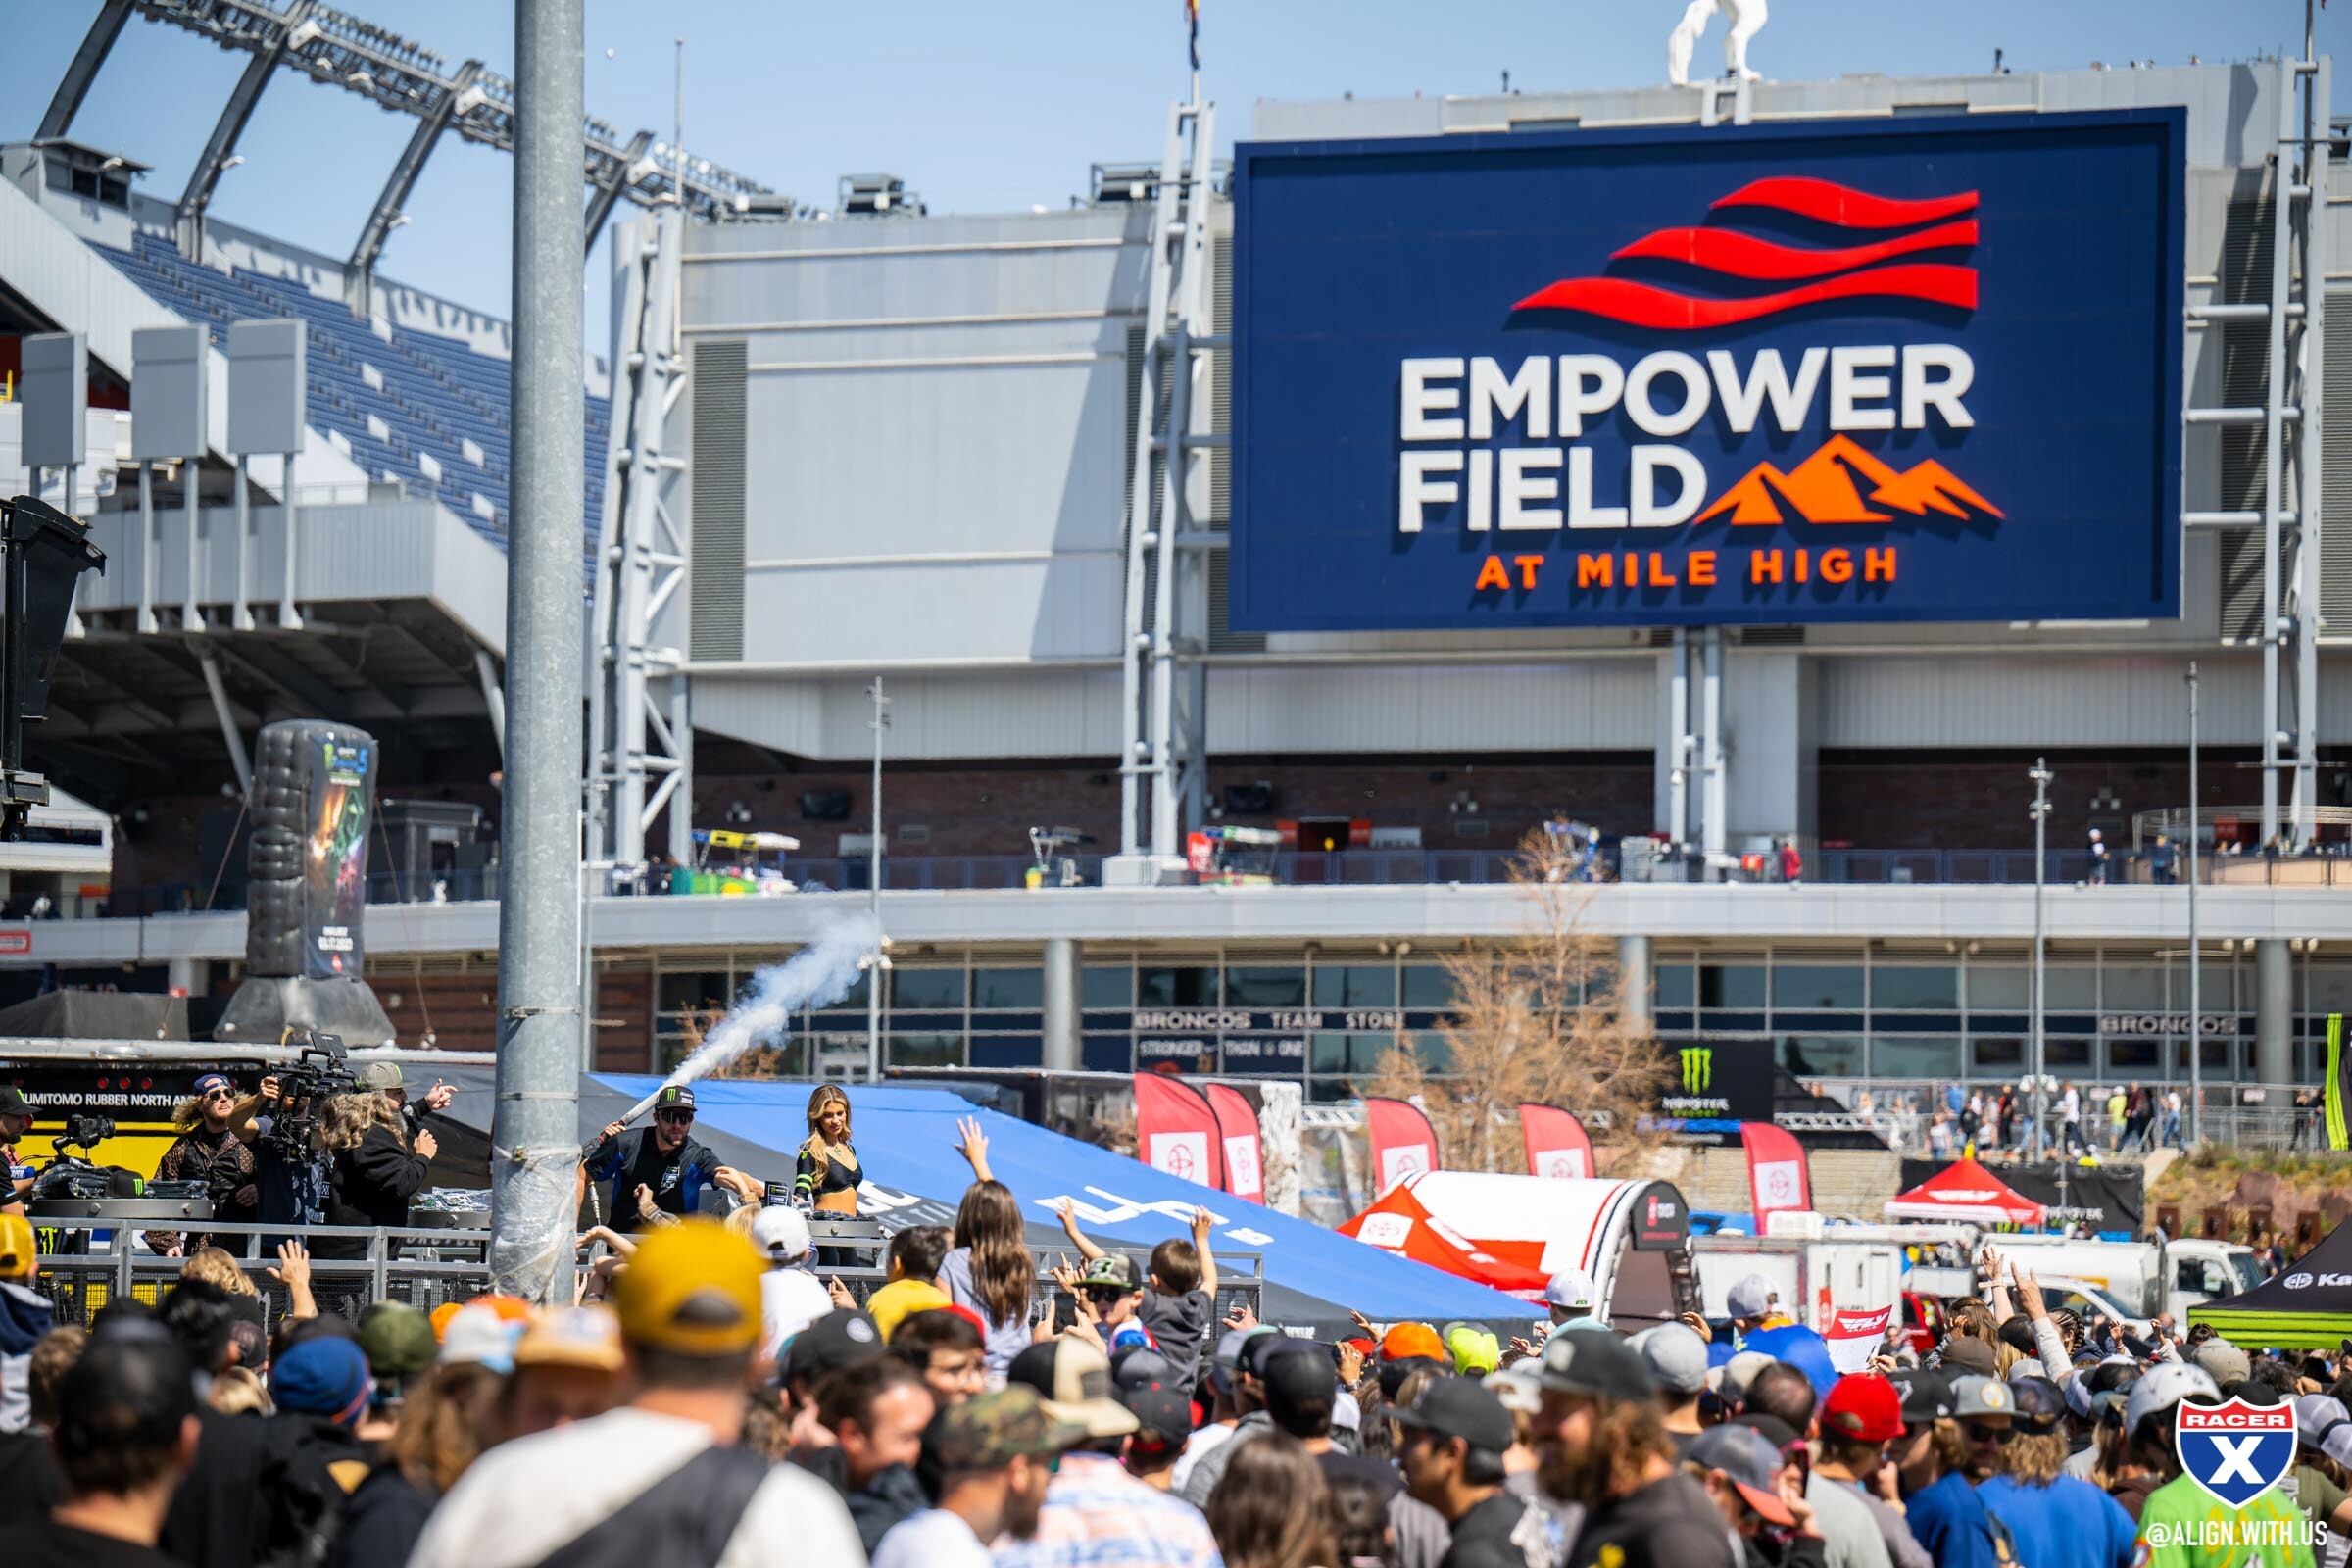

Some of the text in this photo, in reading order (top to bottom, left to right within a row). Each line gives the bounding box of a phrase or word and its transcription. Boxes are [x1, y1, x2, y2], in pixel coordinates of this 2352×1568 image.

[1400, 343, 1976, 441] EMPOWER
[1399, 444, 1708, 533] FIELD
[1475, 547, 1897, 590] AT MILE HIGH
[1133, 1011, 1252, 1030] BRONCOS
[1270, 1012, 1323, 1029] TEAM
[2100, 1015, 2238, 1035] BRONCOS
[85, 1093, 129, 1106] RUBBER
[130, 1094, 172, 1106] NORTH
